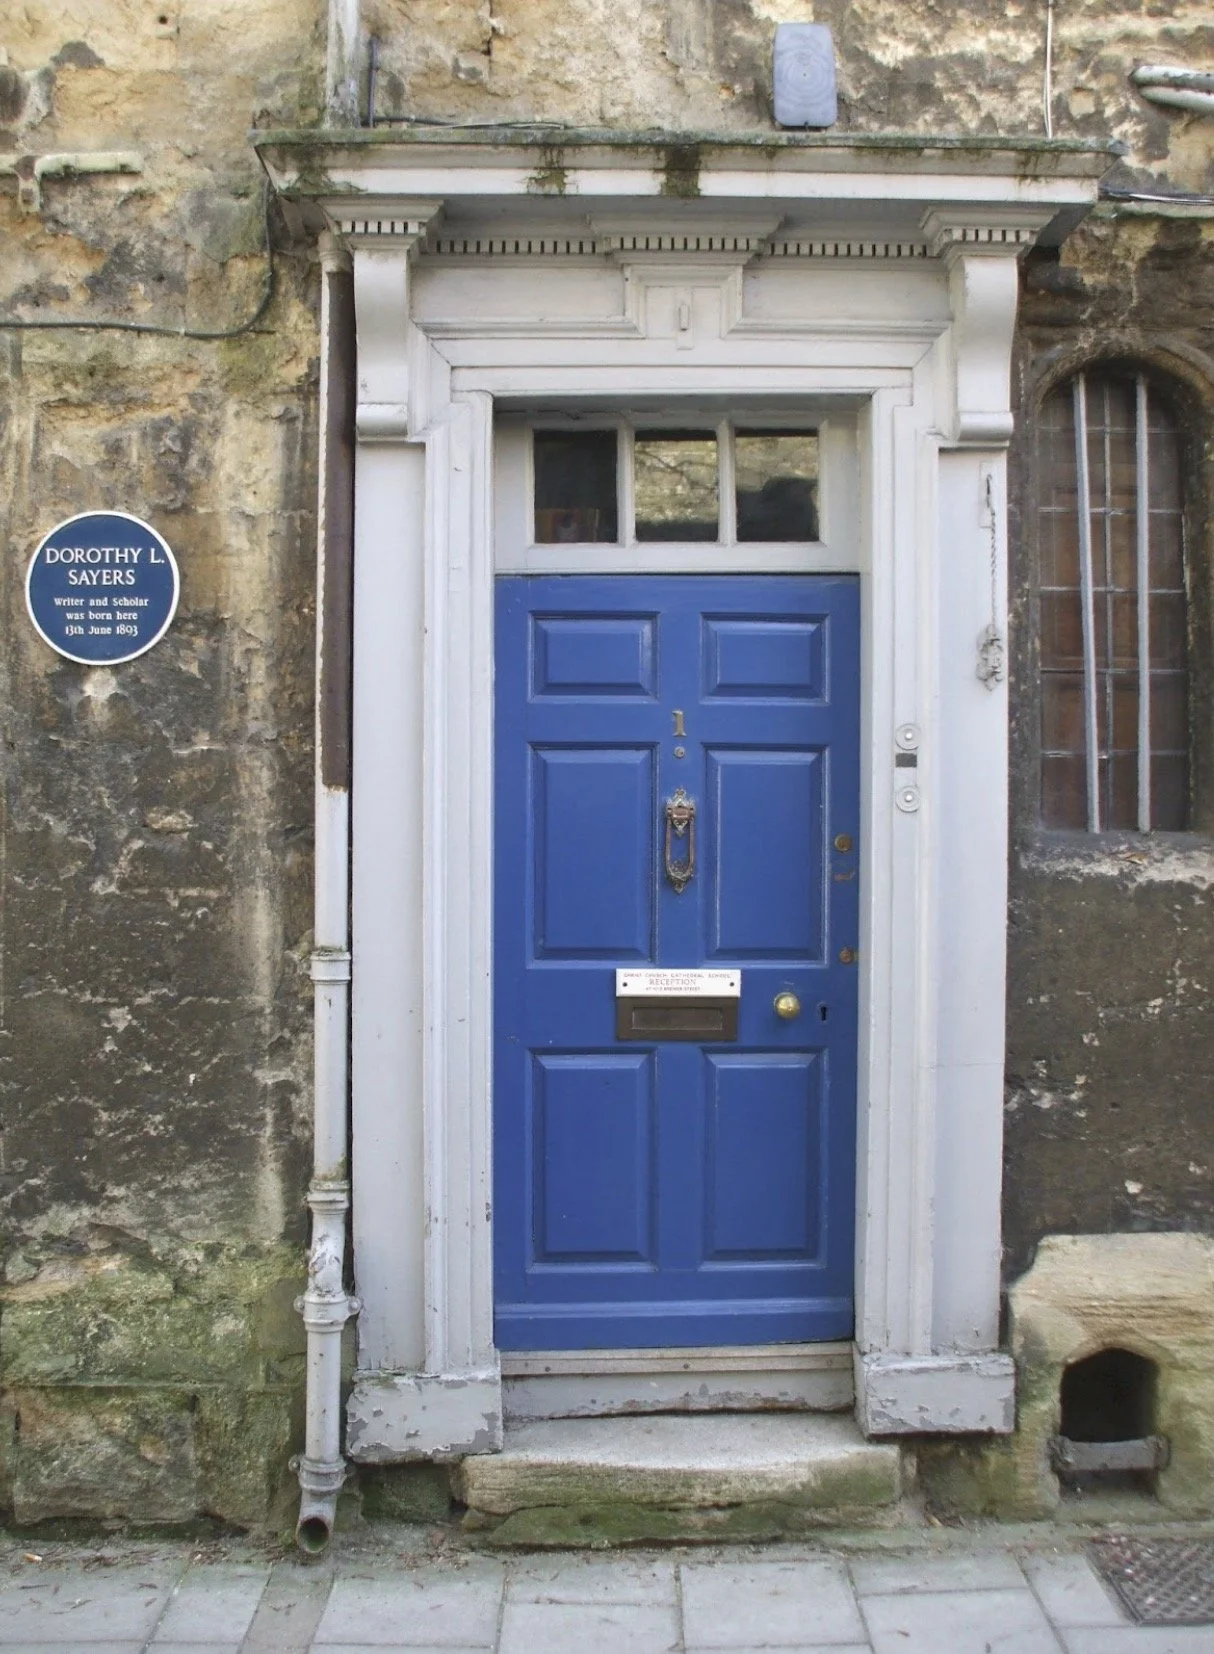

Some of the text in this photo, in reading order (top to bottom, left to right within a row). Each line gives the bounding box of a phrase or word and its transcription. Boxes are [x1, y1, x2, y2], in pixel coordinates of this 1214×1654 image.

[45, 547, 165, 564] DOROTHY L.
[68, 569, 136, 586] SAYERS
[54, 596, 149, 607] Writer and Scholar
[66, 611, 138, 620] was born here
[65, 624, 138, 637] 13th June 1893
[671, 709, 687, 738] 1
[649, 978, 697, 986] RECEPTION
